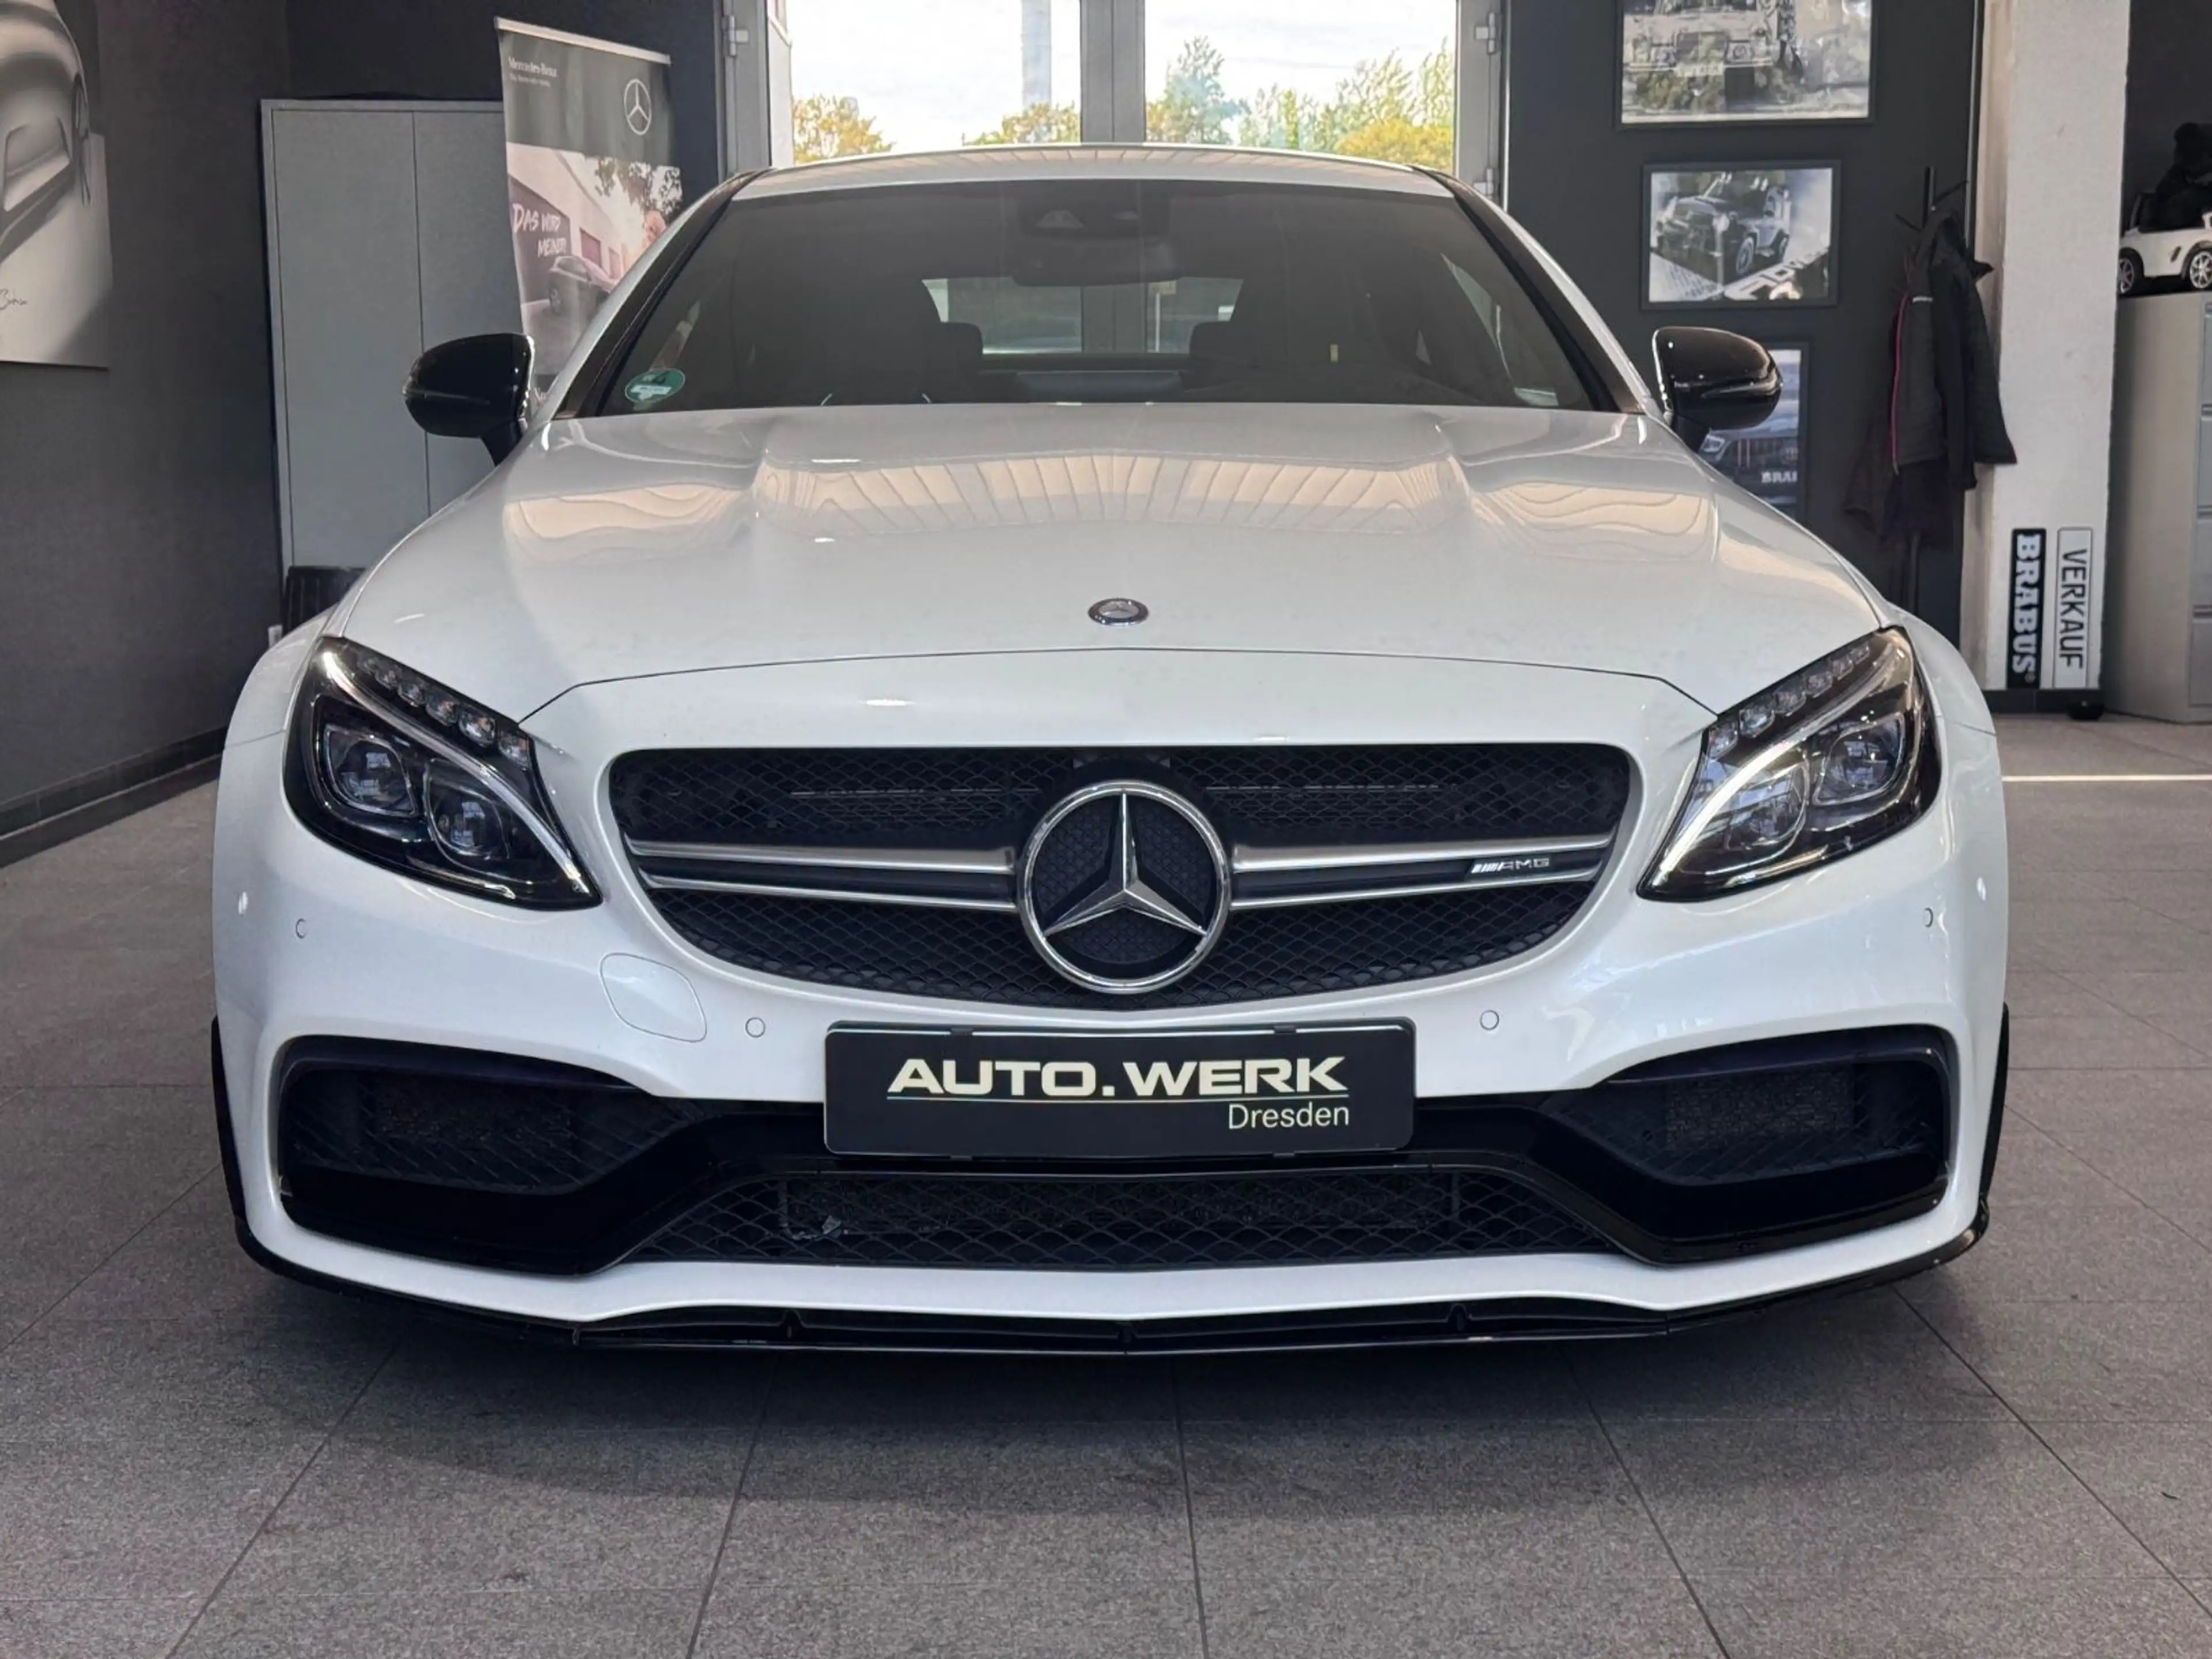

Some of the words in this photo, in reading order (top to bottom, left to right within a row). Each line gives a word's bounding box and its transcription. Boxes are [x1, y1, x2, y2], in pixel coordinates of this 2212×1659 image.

[512, 203, 539, 233] DAS
[2012, 533, 2041, 673] BRABUS
[2059, 548, 2088, 670] VERKAUF
[1498, 858, 1550, 871] AMG
[1228, 1101, 1350, 1131] Dresden
